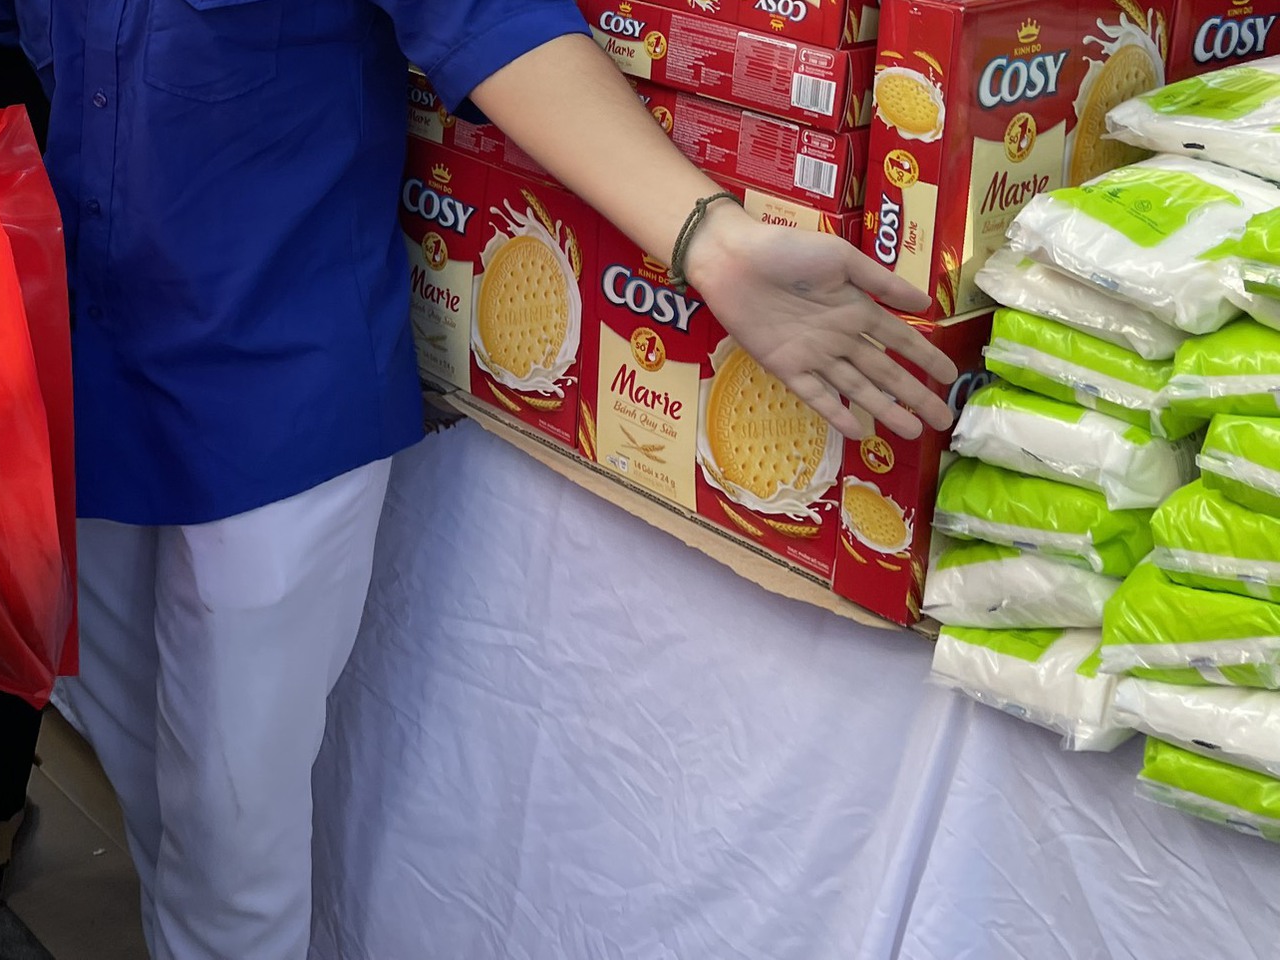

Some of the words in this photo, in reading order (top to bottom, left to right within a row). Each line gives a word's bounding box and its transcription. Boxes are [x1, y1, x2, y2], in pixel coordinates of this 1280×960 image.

[600, 11, 645, 37] COSY
[1193, 15, 1276, 63] COSY
[979, 52, 1066, 108] COSY
[402, 179, 474, 234] COSY
[875, 193, 901, 264] COSY
[411, 265, 460, 312] Marie
[602, 264, 700, 331] COSY
[638, 268, 657, 281] KINH
[611, 364, 683, 420] Marie
[613, 401, 637, 420] Bánh
